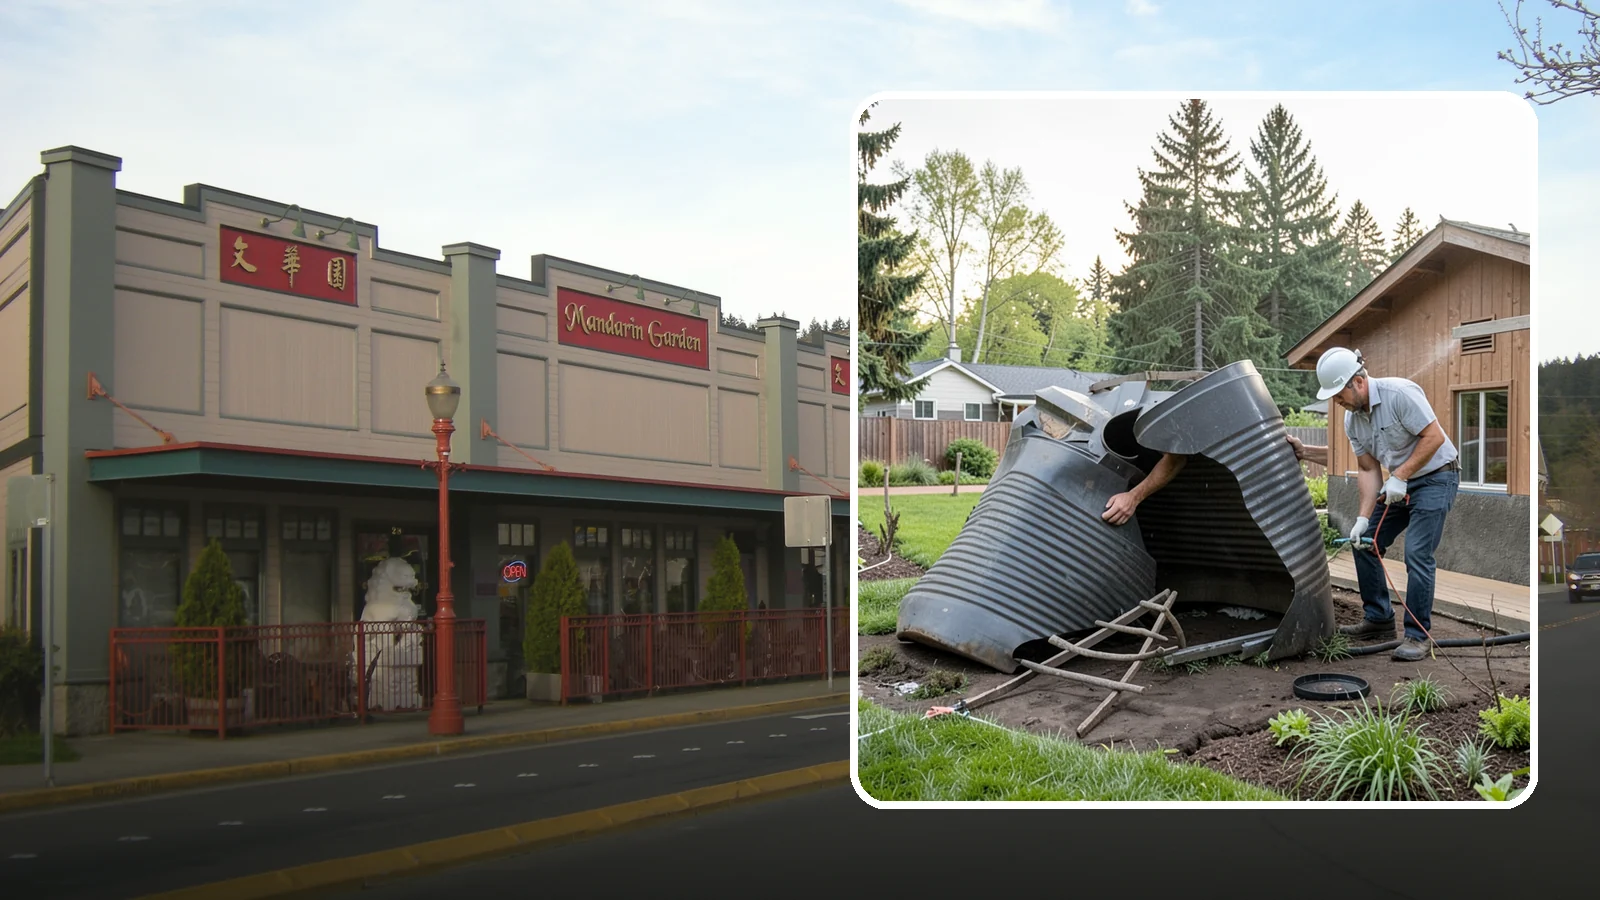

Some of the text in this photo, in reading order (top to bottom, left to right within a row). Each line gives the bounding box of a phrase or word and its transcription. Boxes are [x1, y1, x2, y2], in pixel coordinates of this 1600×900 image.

[231, 235, 346, 291] 文華園
[564, 302, 701, 352] Mandarin Garden
[503, 565, 527, 578] OPEN
